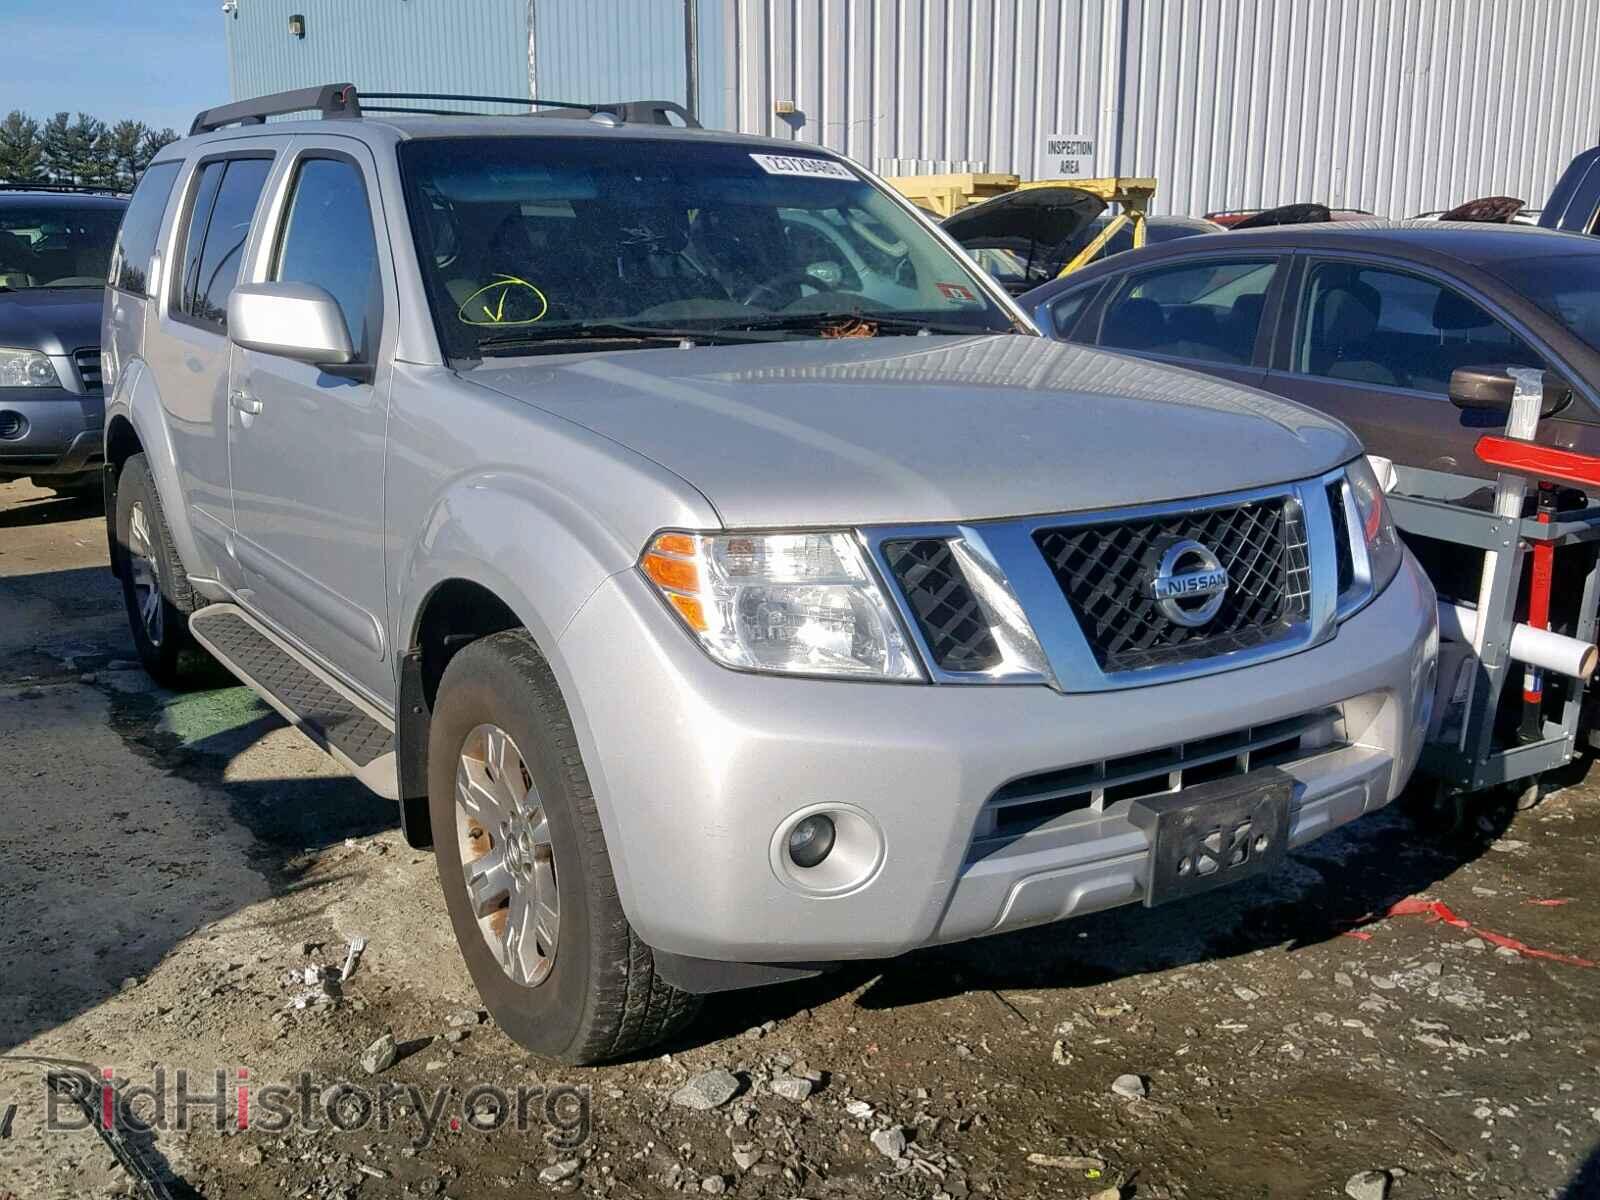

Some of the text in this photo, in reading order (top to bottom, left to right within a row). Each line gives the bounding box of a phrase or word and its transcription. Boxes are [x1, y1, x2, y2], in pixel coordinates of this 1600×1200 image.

[1048, 140, 1093, 155] INSPECTION
[1060, 160, 1080, 174] AREA
[1168, 573, 1226, 594] NISSAN
